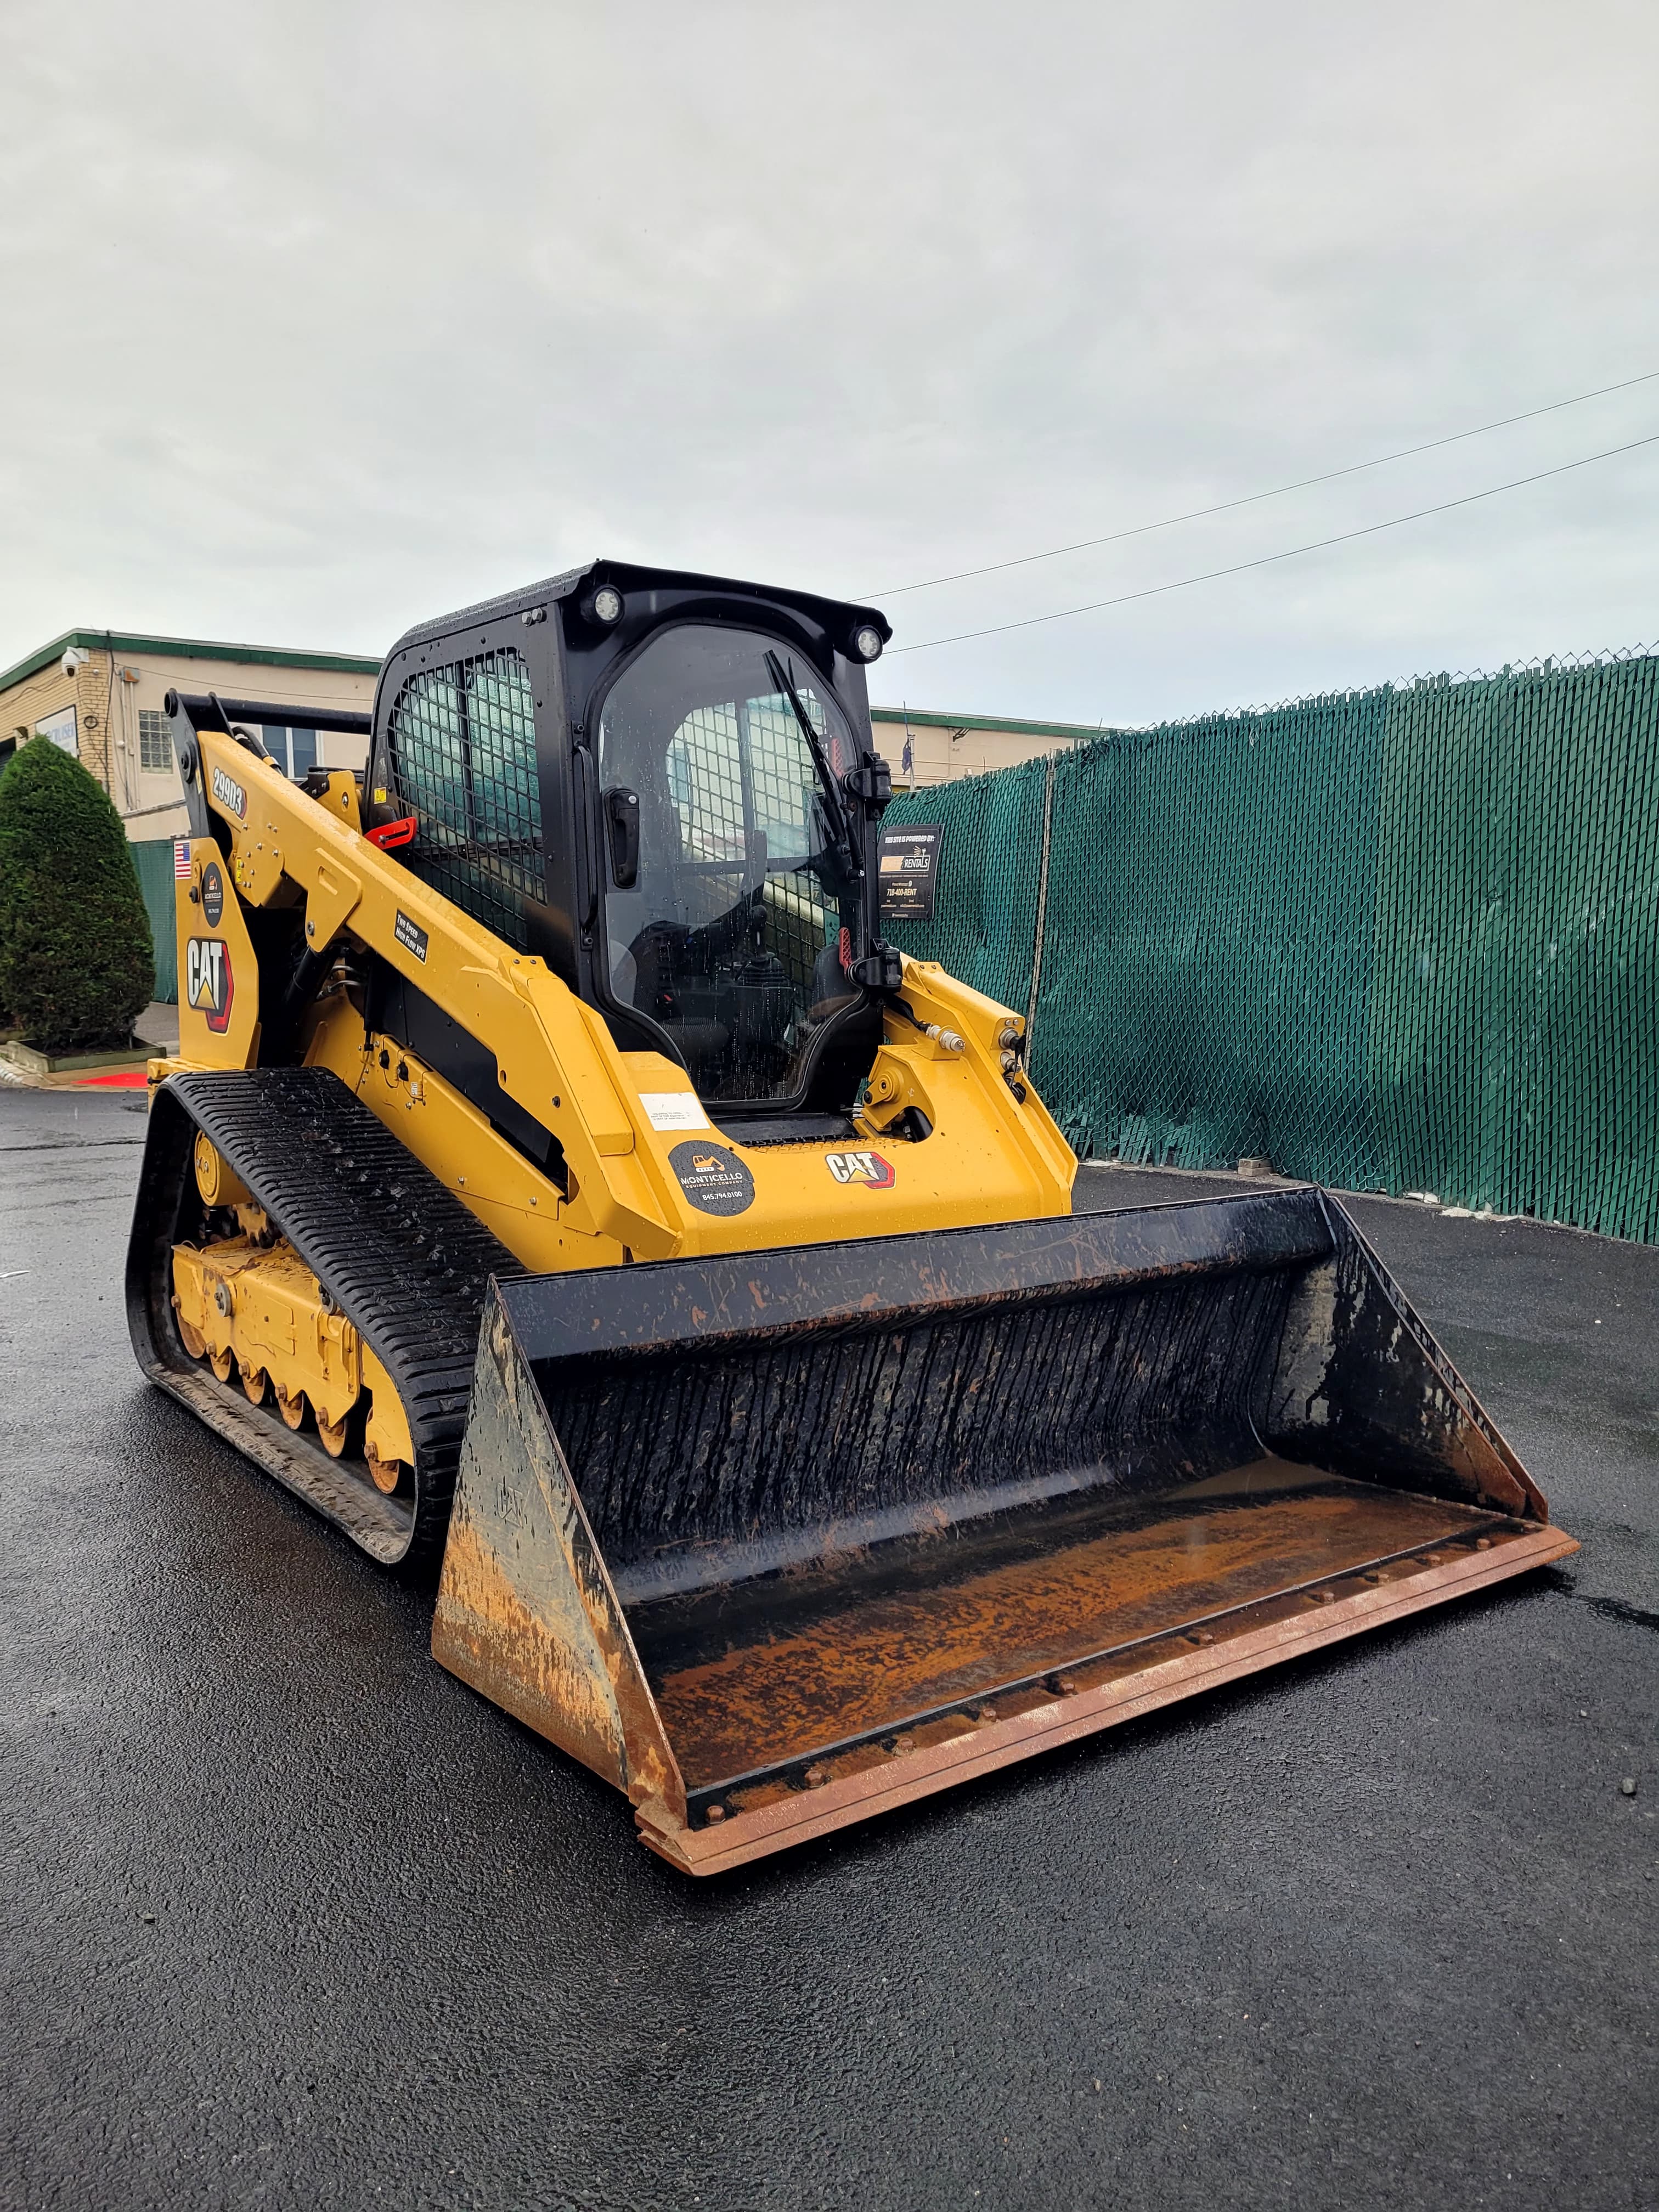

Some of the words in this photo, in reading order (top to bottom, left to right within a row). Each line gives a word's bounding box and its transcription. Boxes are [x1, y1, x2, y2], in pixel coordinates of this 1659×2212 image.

[213, 768, 242, 815] 299D3
[904, 859, 928, 868] RENTALS
[405, 922, 418, 939] SPEED
[396, 927, 405, 941] HIGH
[405, 935, 416, 950] FLOW
[415, 944, 425, 958] XPS
[188, 939, 222, 1009] CAT
[680, 1172, 743, 1185] MONTICELLO
[826, 1153, 880, 1183] CAT
[702, 1191, 743, 1200] 845.794.0100
